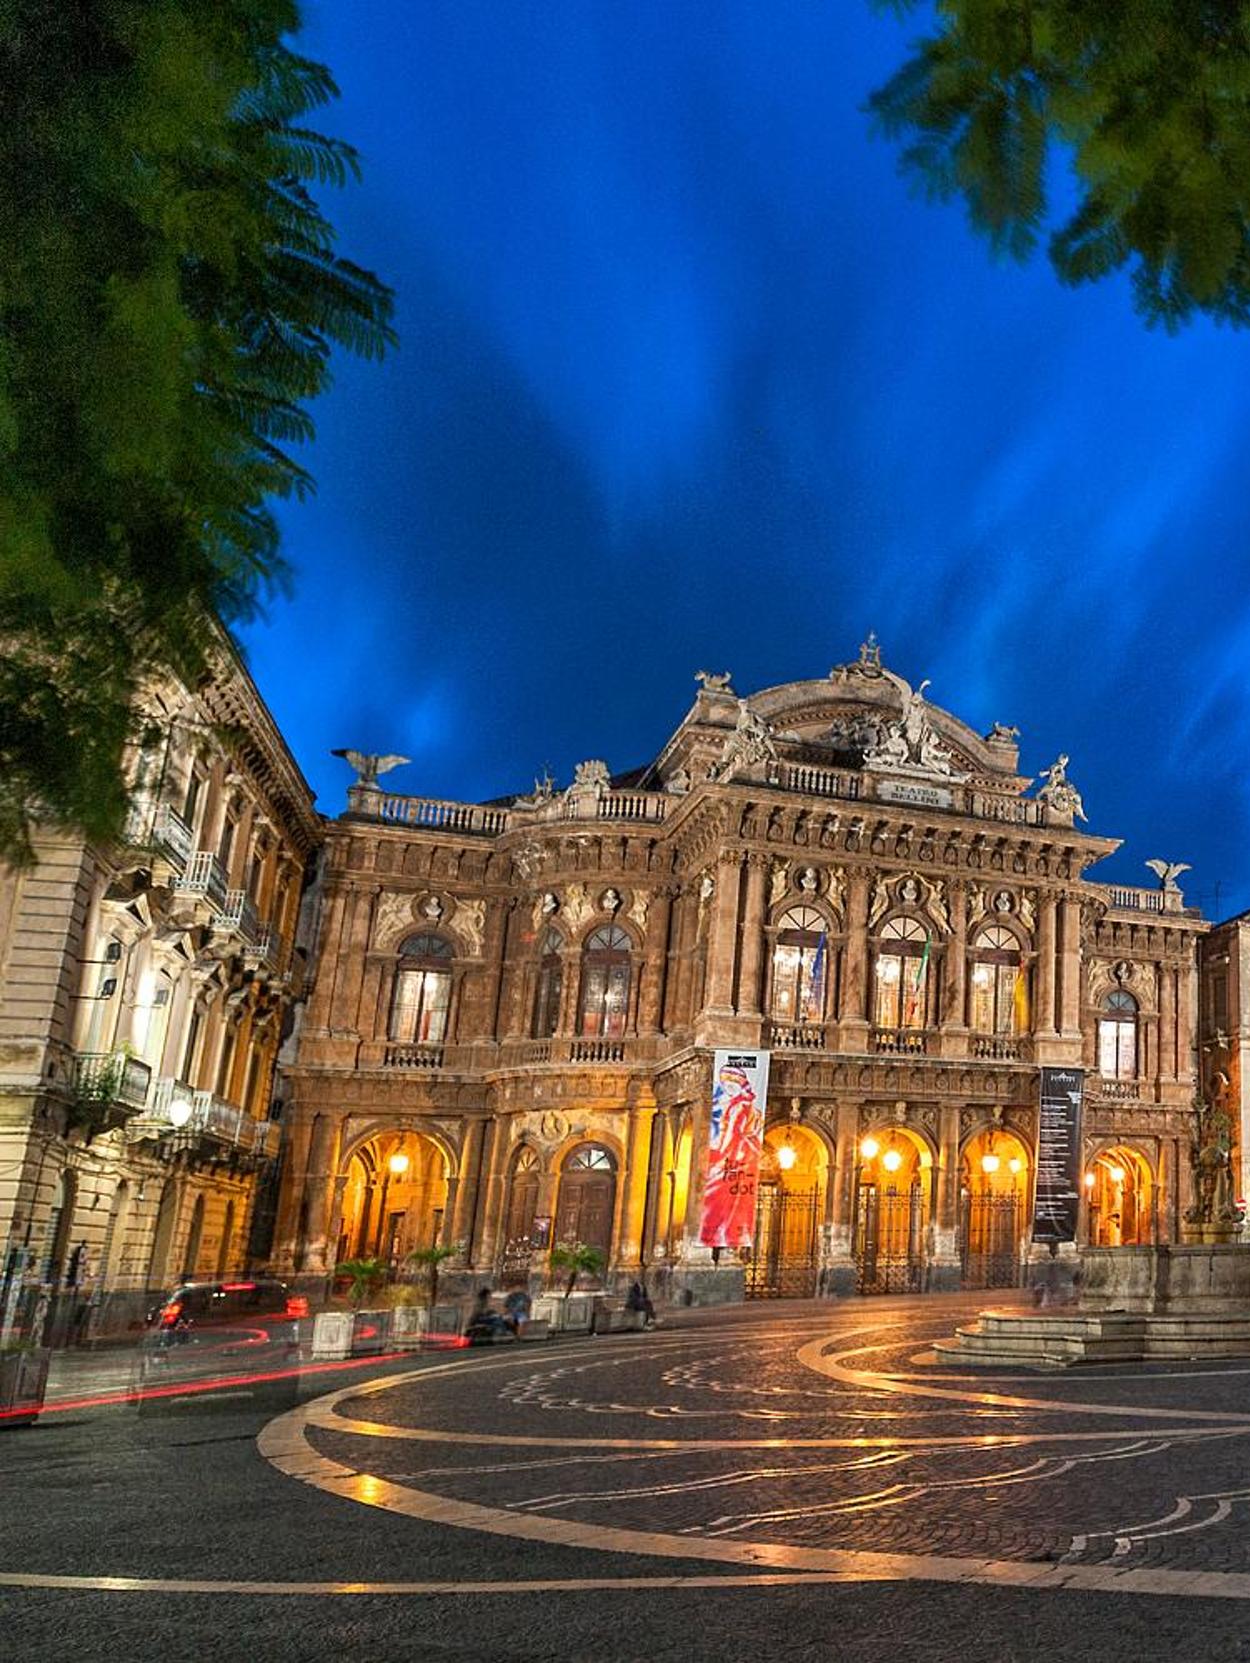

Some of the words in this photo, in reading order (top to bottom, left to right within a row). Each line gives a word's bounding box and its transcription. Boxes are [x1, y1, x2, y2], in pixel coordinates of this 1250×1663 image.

[893, 785, 938, 797] TEATRO
[891, 792, 939, 805] BELLINI
[729, 1182, 755, 1196] dot
